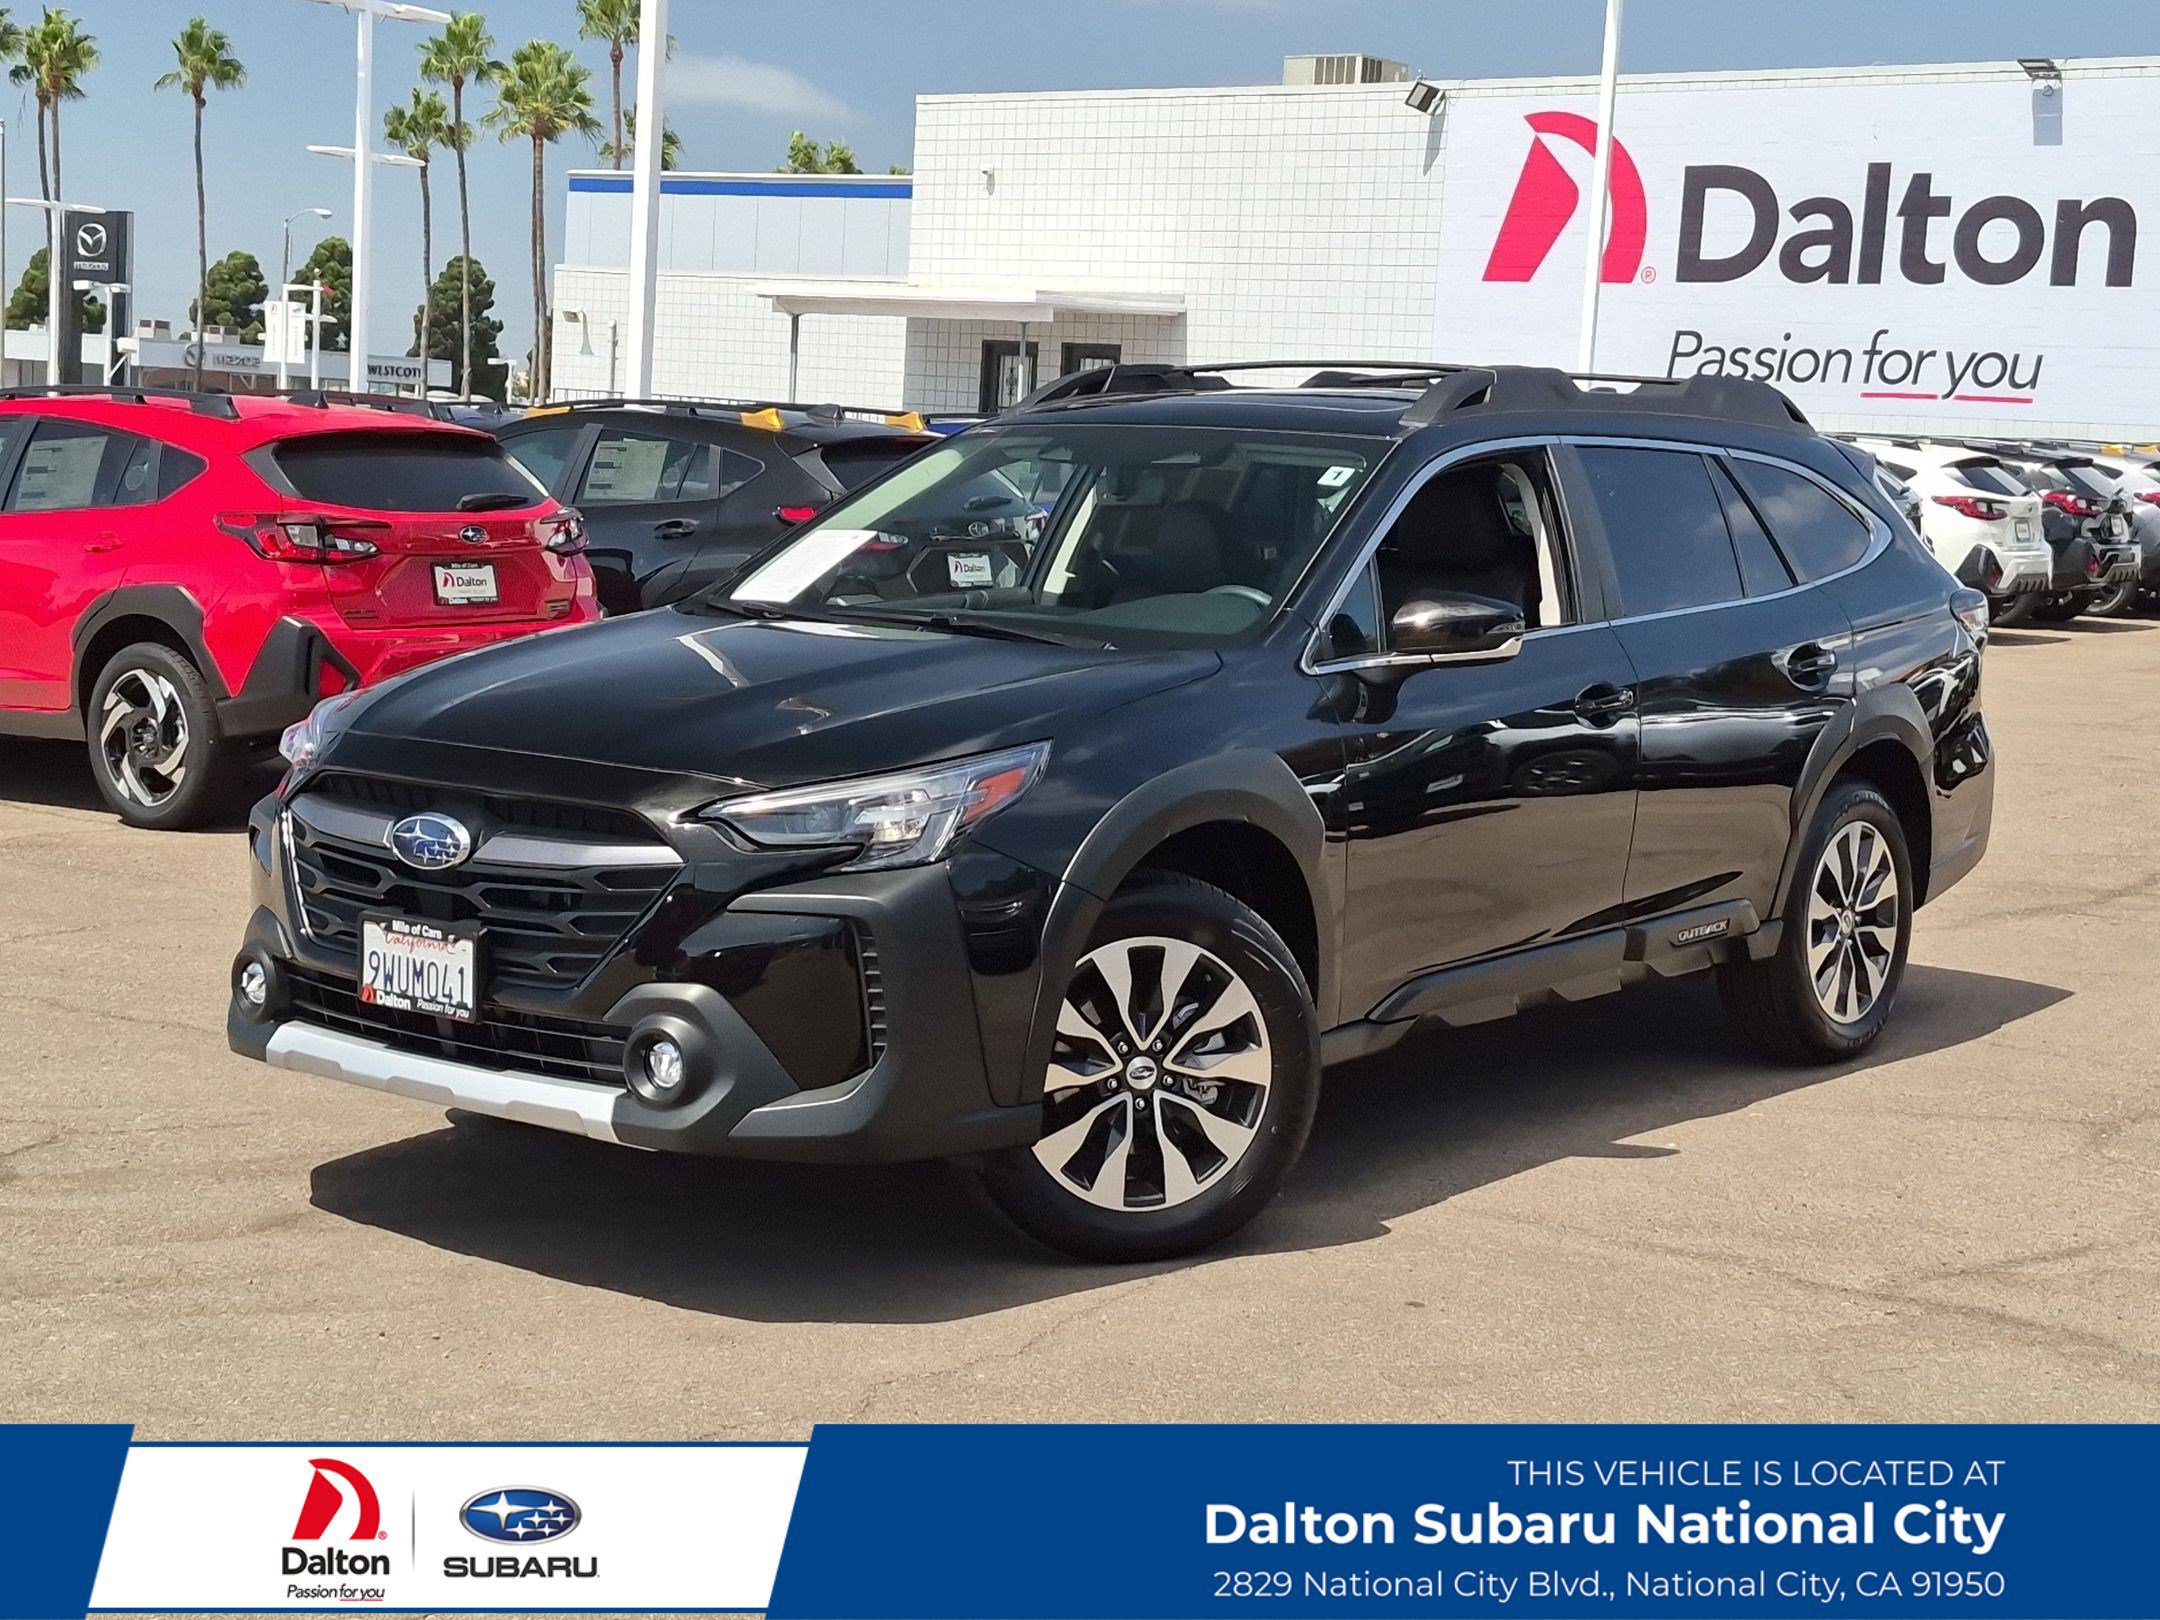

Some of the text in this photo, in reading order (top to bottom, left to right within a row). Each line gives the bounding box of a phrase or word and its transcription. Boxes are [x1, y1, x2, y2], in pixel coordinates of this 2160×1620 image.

[1675, 161, 2137, 287] Dalton
[1665, 328, 2044, 400] Passion for you
[456, 576, 488, 587] Dalton
[392, 920, 442, 940] Mile of Cars
[1678, 919, 1728, 941] OUTBACK
[385, 931, 456, 954] California
[368, 950, 468, 1007] 9WUM041
[376, 990, 411, 1011] Dalton
[417, 999, 470, 1019] Passion for you
